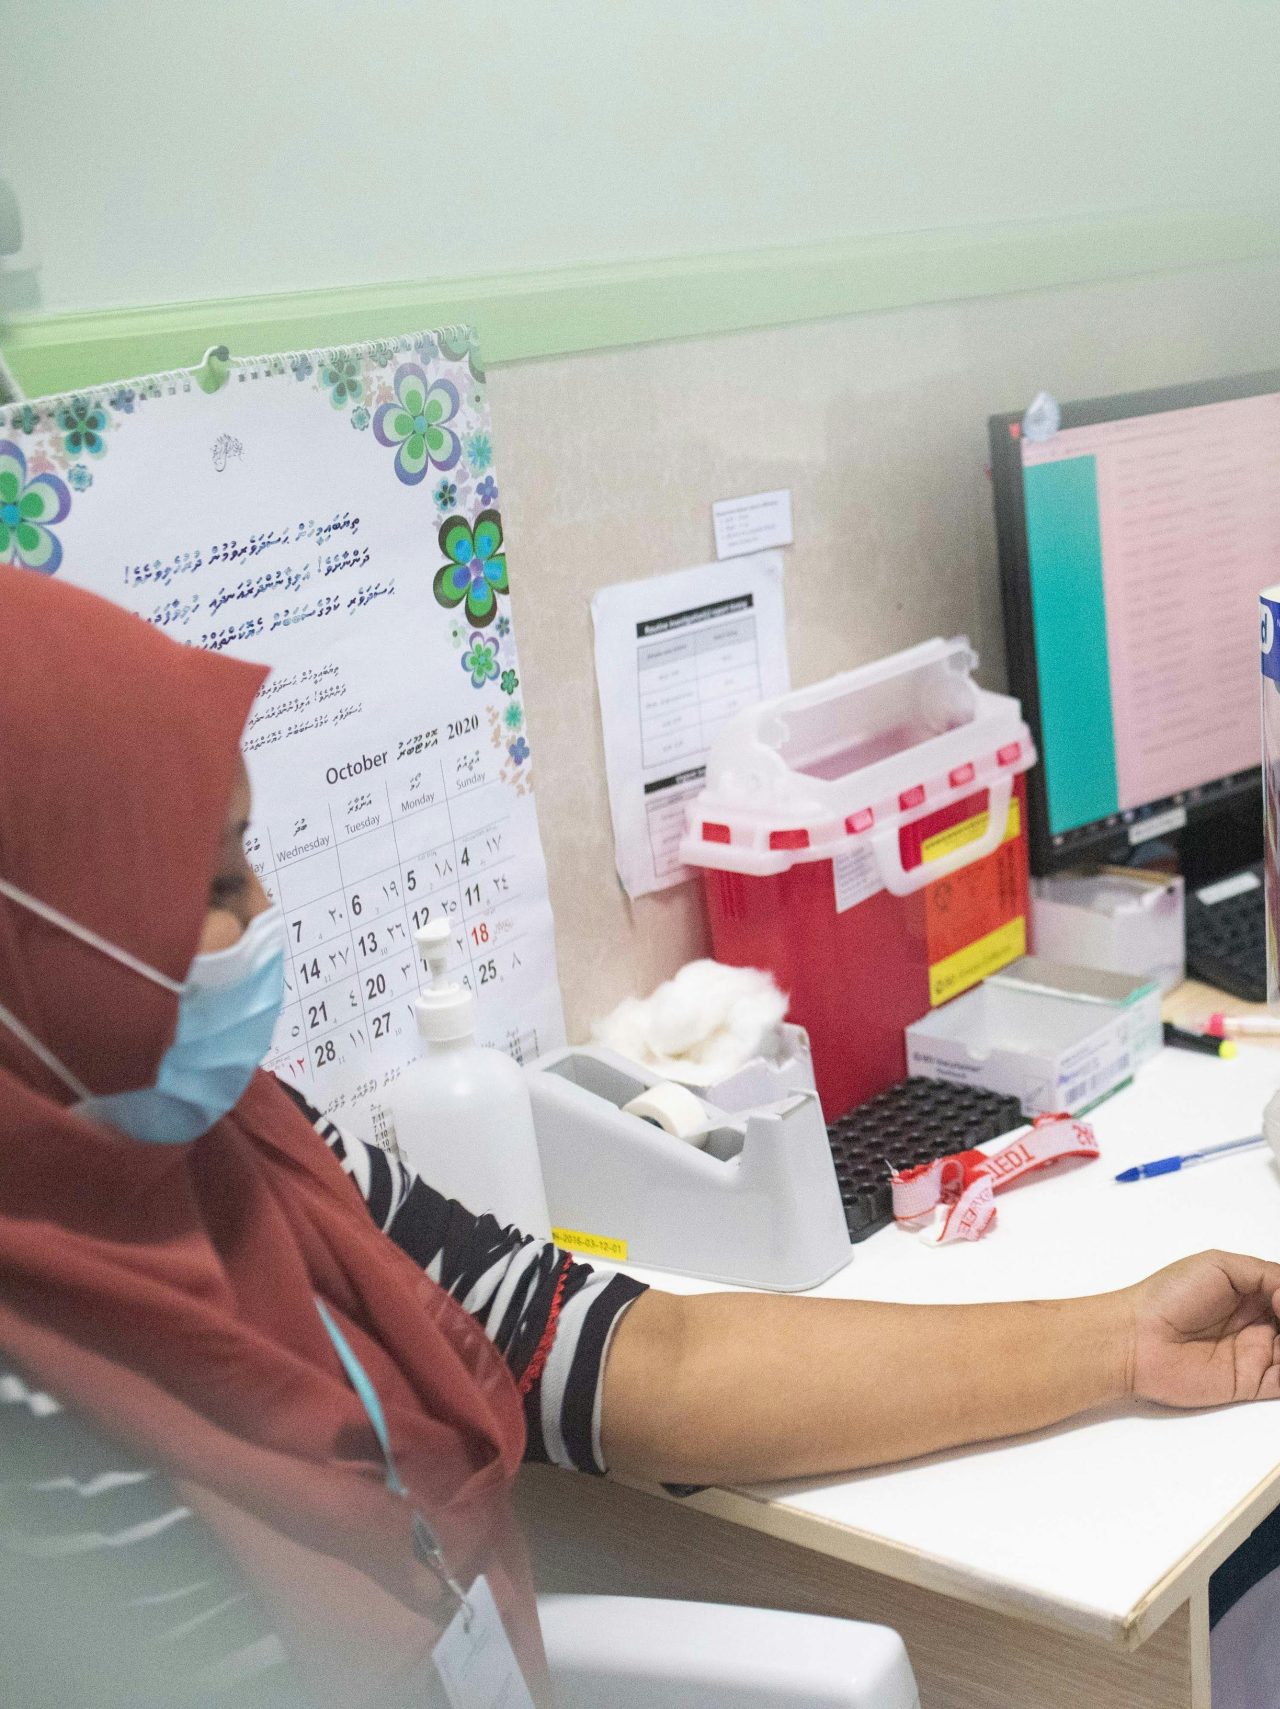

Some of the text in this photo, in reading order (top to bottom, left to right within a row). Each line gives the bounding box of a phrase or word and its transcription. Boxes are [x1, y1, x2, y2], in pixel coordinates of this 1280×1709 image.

[326, 750, 388, 785] October
[447, 714, 479, 741] 2020
[456, 772, 485, 791] Sunday
[401, 790, 435, 812] Monday
[344, 814, 381, 835] Tuesday
[276, 834, 331, 863] Wednesday
[460, 847, 470, 867] 4
[407, 870, 417, 891] 5
[352, 894, 362, 916] 6
[465, 883, 480, 906] 11
[292, 920, 302, 943] 7
[358, 931, 378, 957] 13
[472, 923, 489, 947] 18
[300, 958, 321, 984] 14
[479, 959, 497, 985] 25
[366, 973, 386, 1000] 20
[308, 1001, 328, 1029] 21
[372, 1011, 391, 1039] 27
[315, 1040, 336, 1068] 28
